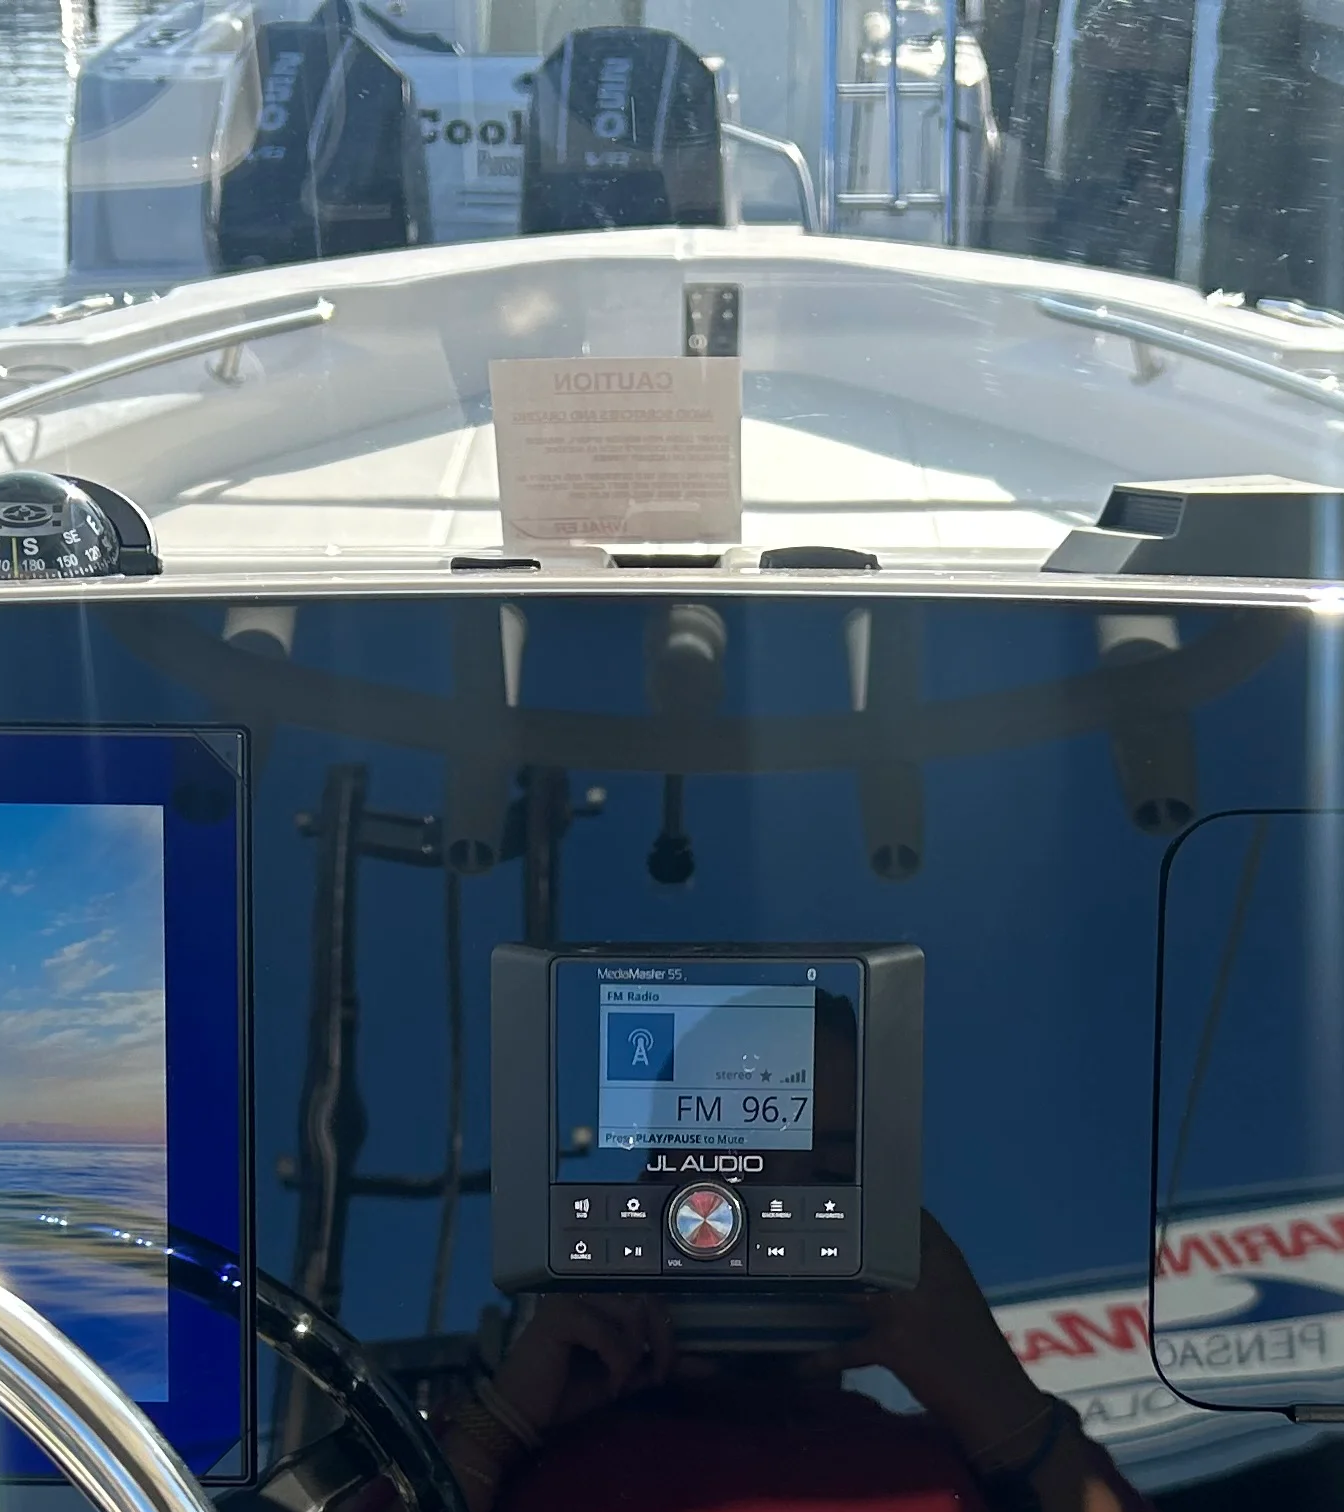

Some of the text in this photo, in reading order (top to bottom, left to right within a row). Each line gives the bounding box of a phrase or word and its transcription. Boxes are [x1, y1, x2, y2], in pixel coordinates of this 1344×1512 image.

[22, 537, 39, 556] S
[62, 528, 82, 546] SE
[21, 558, 46, 573] 180
[56, 552, 79, 569] 150
[607, 990, 660, 1002] FM Radio
[715, 1069, 752, 1081] stereo
[676, 1095, 809, 1123] FM 96.7
[635, 1133, 702, 1145] PLAY/PAUSE
[703, 1134, 715, 1145] to
[717, 1134, 745, 1145] Mute
[647, 1155, 764, 1173] JL AUDIO
